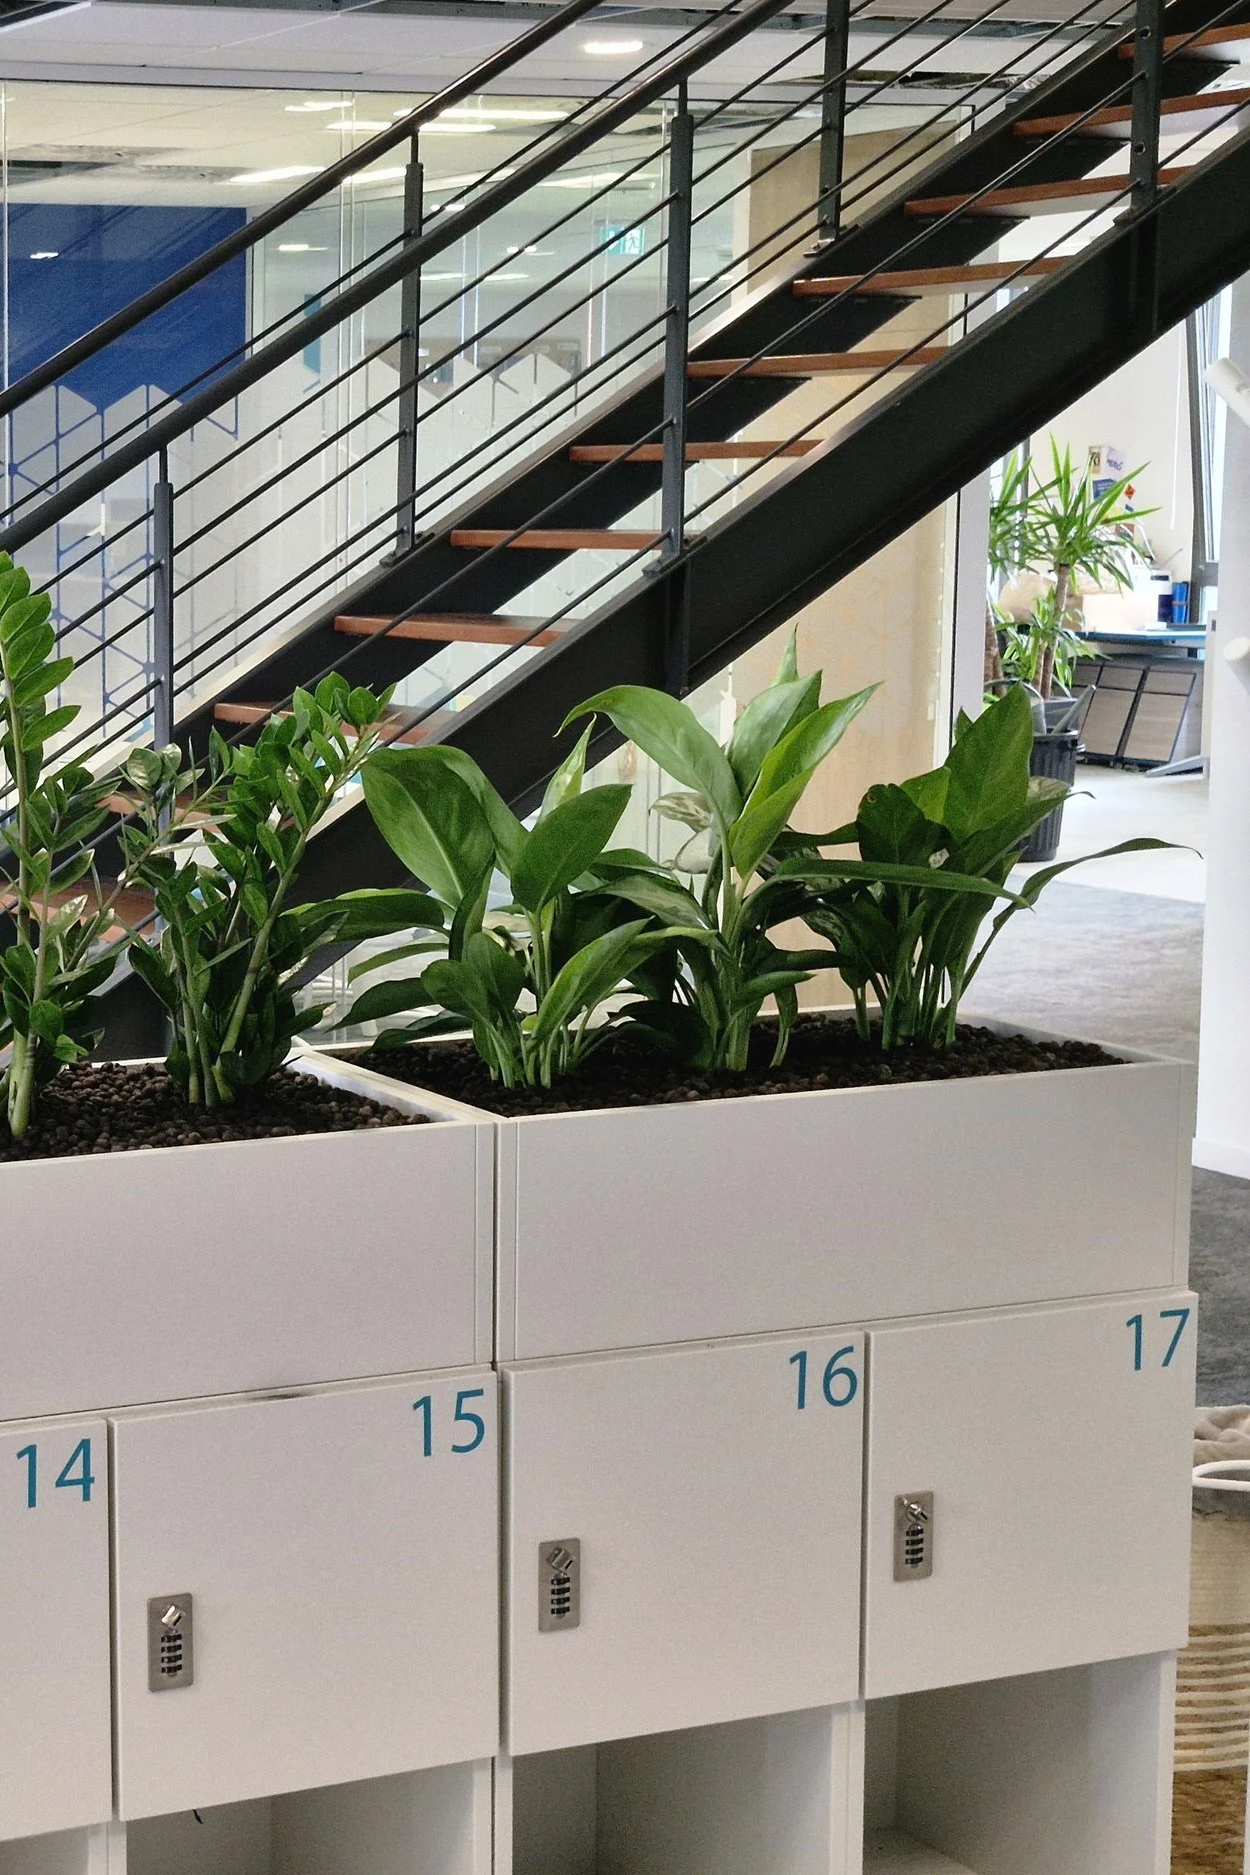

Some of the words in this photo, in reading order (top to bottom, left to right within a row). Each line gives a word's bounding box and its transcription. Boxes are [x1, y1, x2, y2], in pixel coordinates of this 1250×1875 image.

[1125, 1308, 1190, 1371] 17
[789, 1345, 858, 1410] 16
[412, 1388, 486, 1457] 15
[16, 1438, 95, 1508] 14
